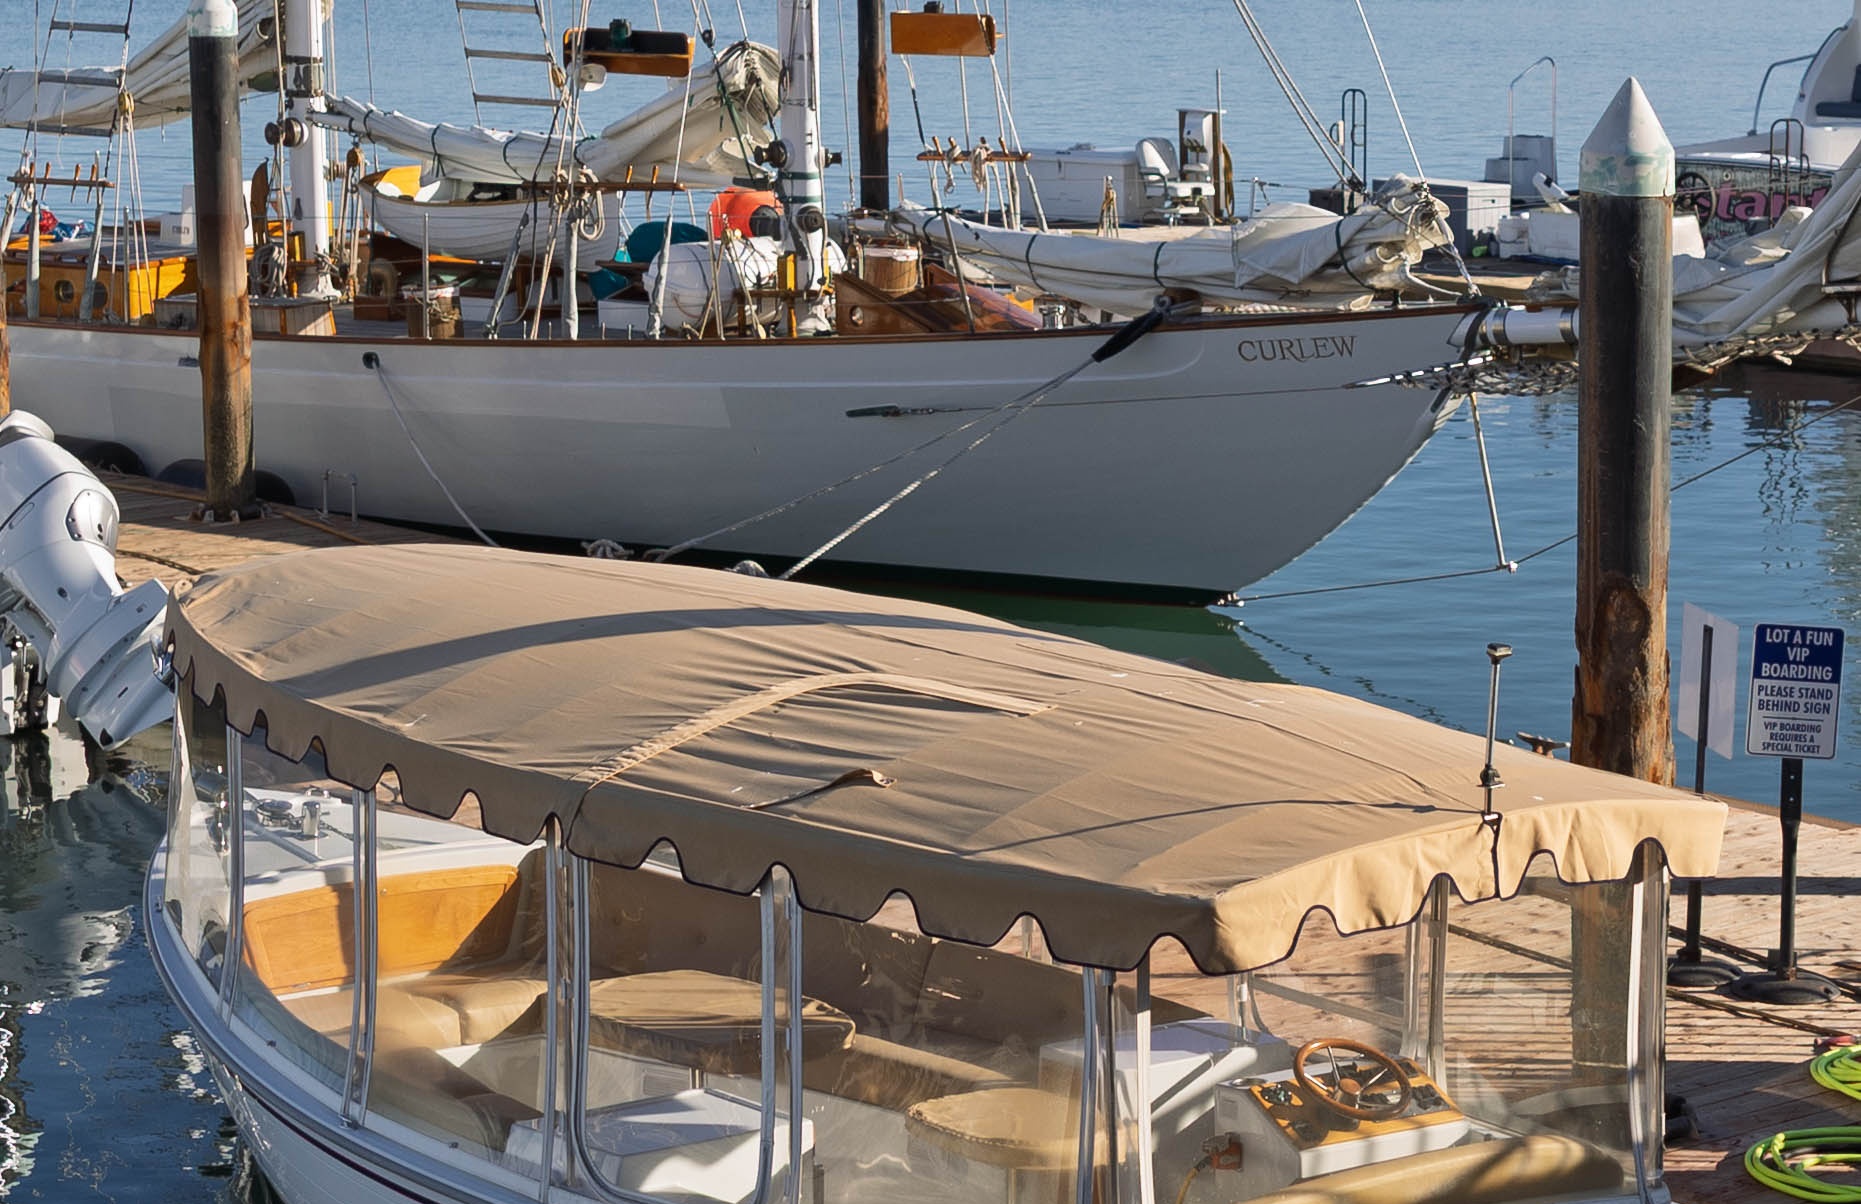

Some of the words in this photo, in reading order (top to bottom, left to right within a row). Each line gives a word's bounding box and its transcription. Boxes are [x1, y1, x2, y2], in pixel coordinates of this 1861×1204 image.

[1237, 335, 1357, 362] CURLEW
[1765, 628, 1790, 643] LOT
[1792, 629, 1802, 645] A
[1806, 630, 1833, 647] FUN
[1787, 646, 1810, 662] VIP
[1761, 662, 1833, 681] BOARDING
[1757, 684, 1795, 699] PLEASE
[1798, 687, 1833, 701] STAND
[1757, 699, 1800, 713] BEHIND
[1803, 701, 1831, 715] SIGN
[1763, 721, 1777, 732] VIP
[1779, 722, 1822, 734] BOARDING
[1769, 732, 1807, 744] REQUIRES
[1808, 734, 1815, 744] A
[1761, 741, 1793, 752] SPECIAL
[1795, 743, 1820, 754] TICKET
